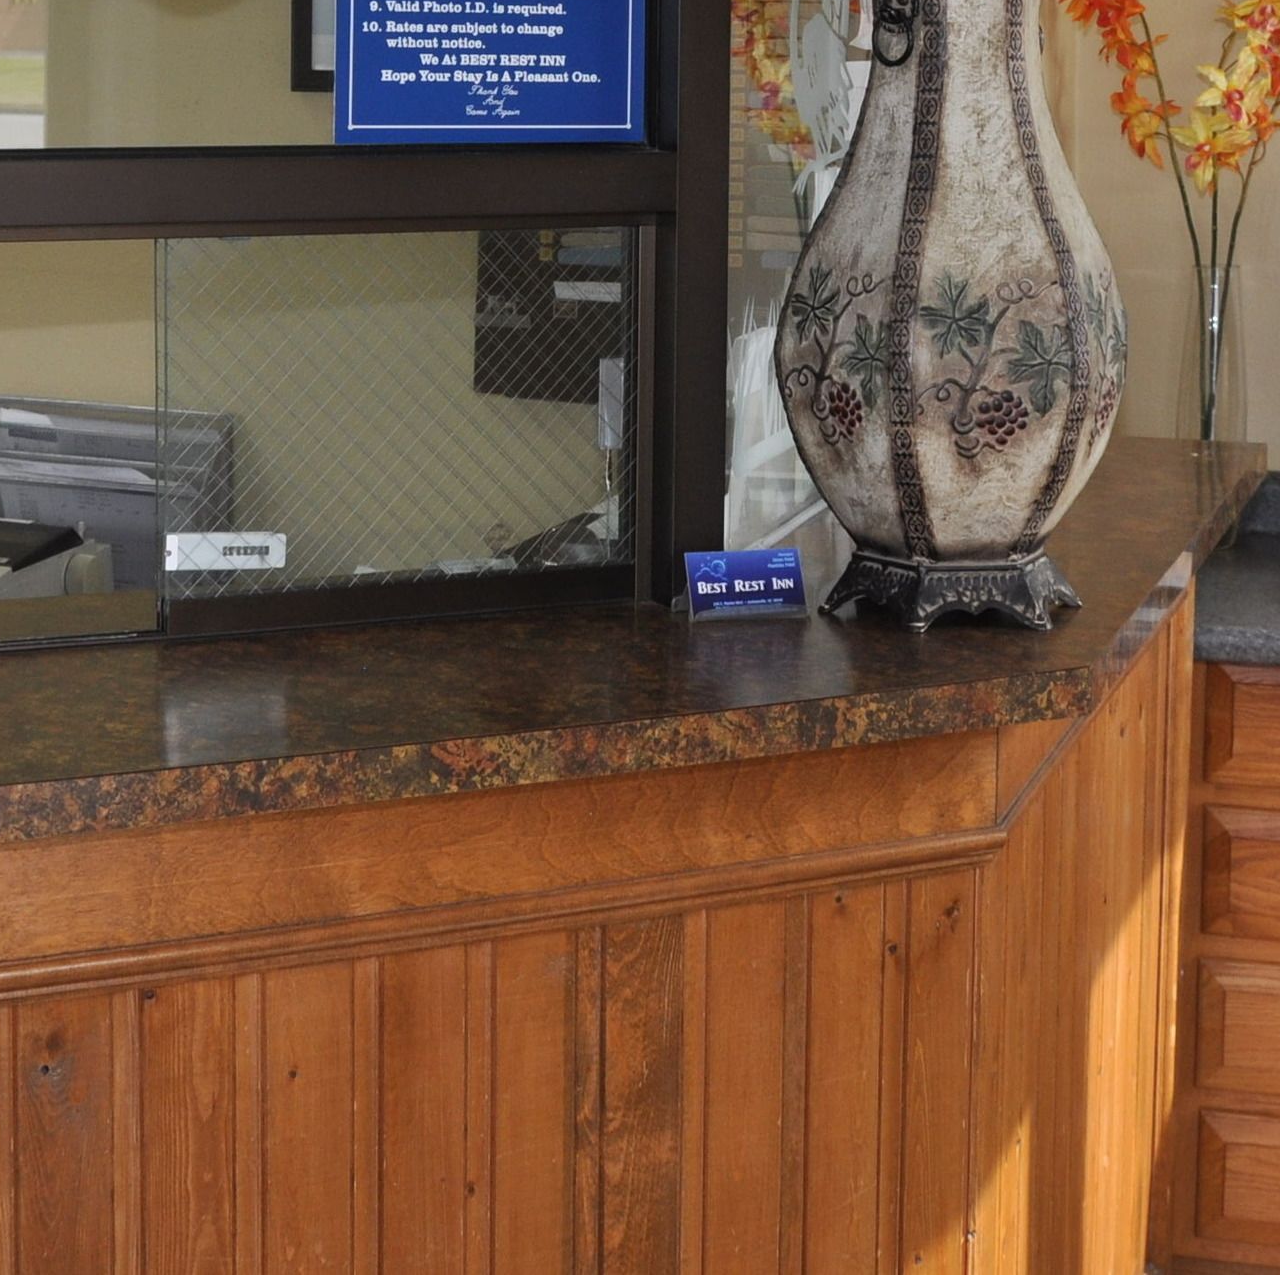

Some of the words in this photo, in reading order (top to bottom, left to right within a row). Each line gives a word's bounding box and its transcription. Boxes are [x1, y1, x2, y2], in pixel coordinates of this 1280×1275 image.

[370, 2, 381, 11] 9.
[386, 1, 420, 13] Valid
[423, 2, 462, 13] Photo
[465, 3, 489, 13] I.D.
[493, 3, 504, 14] is
[507, 3, 566, 17] required.
[362, 22, 381, 32] 10.
[386, 21, 423, 33] Rates
[427, 24, 447, 33] are
[451, 23, 497, 35] subject
[501, 24, 514, 34] to
[517, 23, 563, 35] change
[387, 37, 438, 48] without
[441, 38, 485, 49] notice.
[420, 54, 439, 66] We
[442, 54, 456, 66] At
[460, 55, 497, 66] BEST
[500, 55, 537, 66] REST
[540, 55, 566, 67] INN
[381, 70, 416, 84] Hope
[419, 70, 450, 82] Your
[454, 70, 482, 84] Stay
[486, 70, 498, 82] Is
[501, 71, 511, 82] A
[514, 71, 568, 83] Pleasant
[572, 71, 601, 83] One.
[697, 582, 728, 594] BEST
[734, 579, 766, 593] REST
[772, 577, 794, 590] INN
